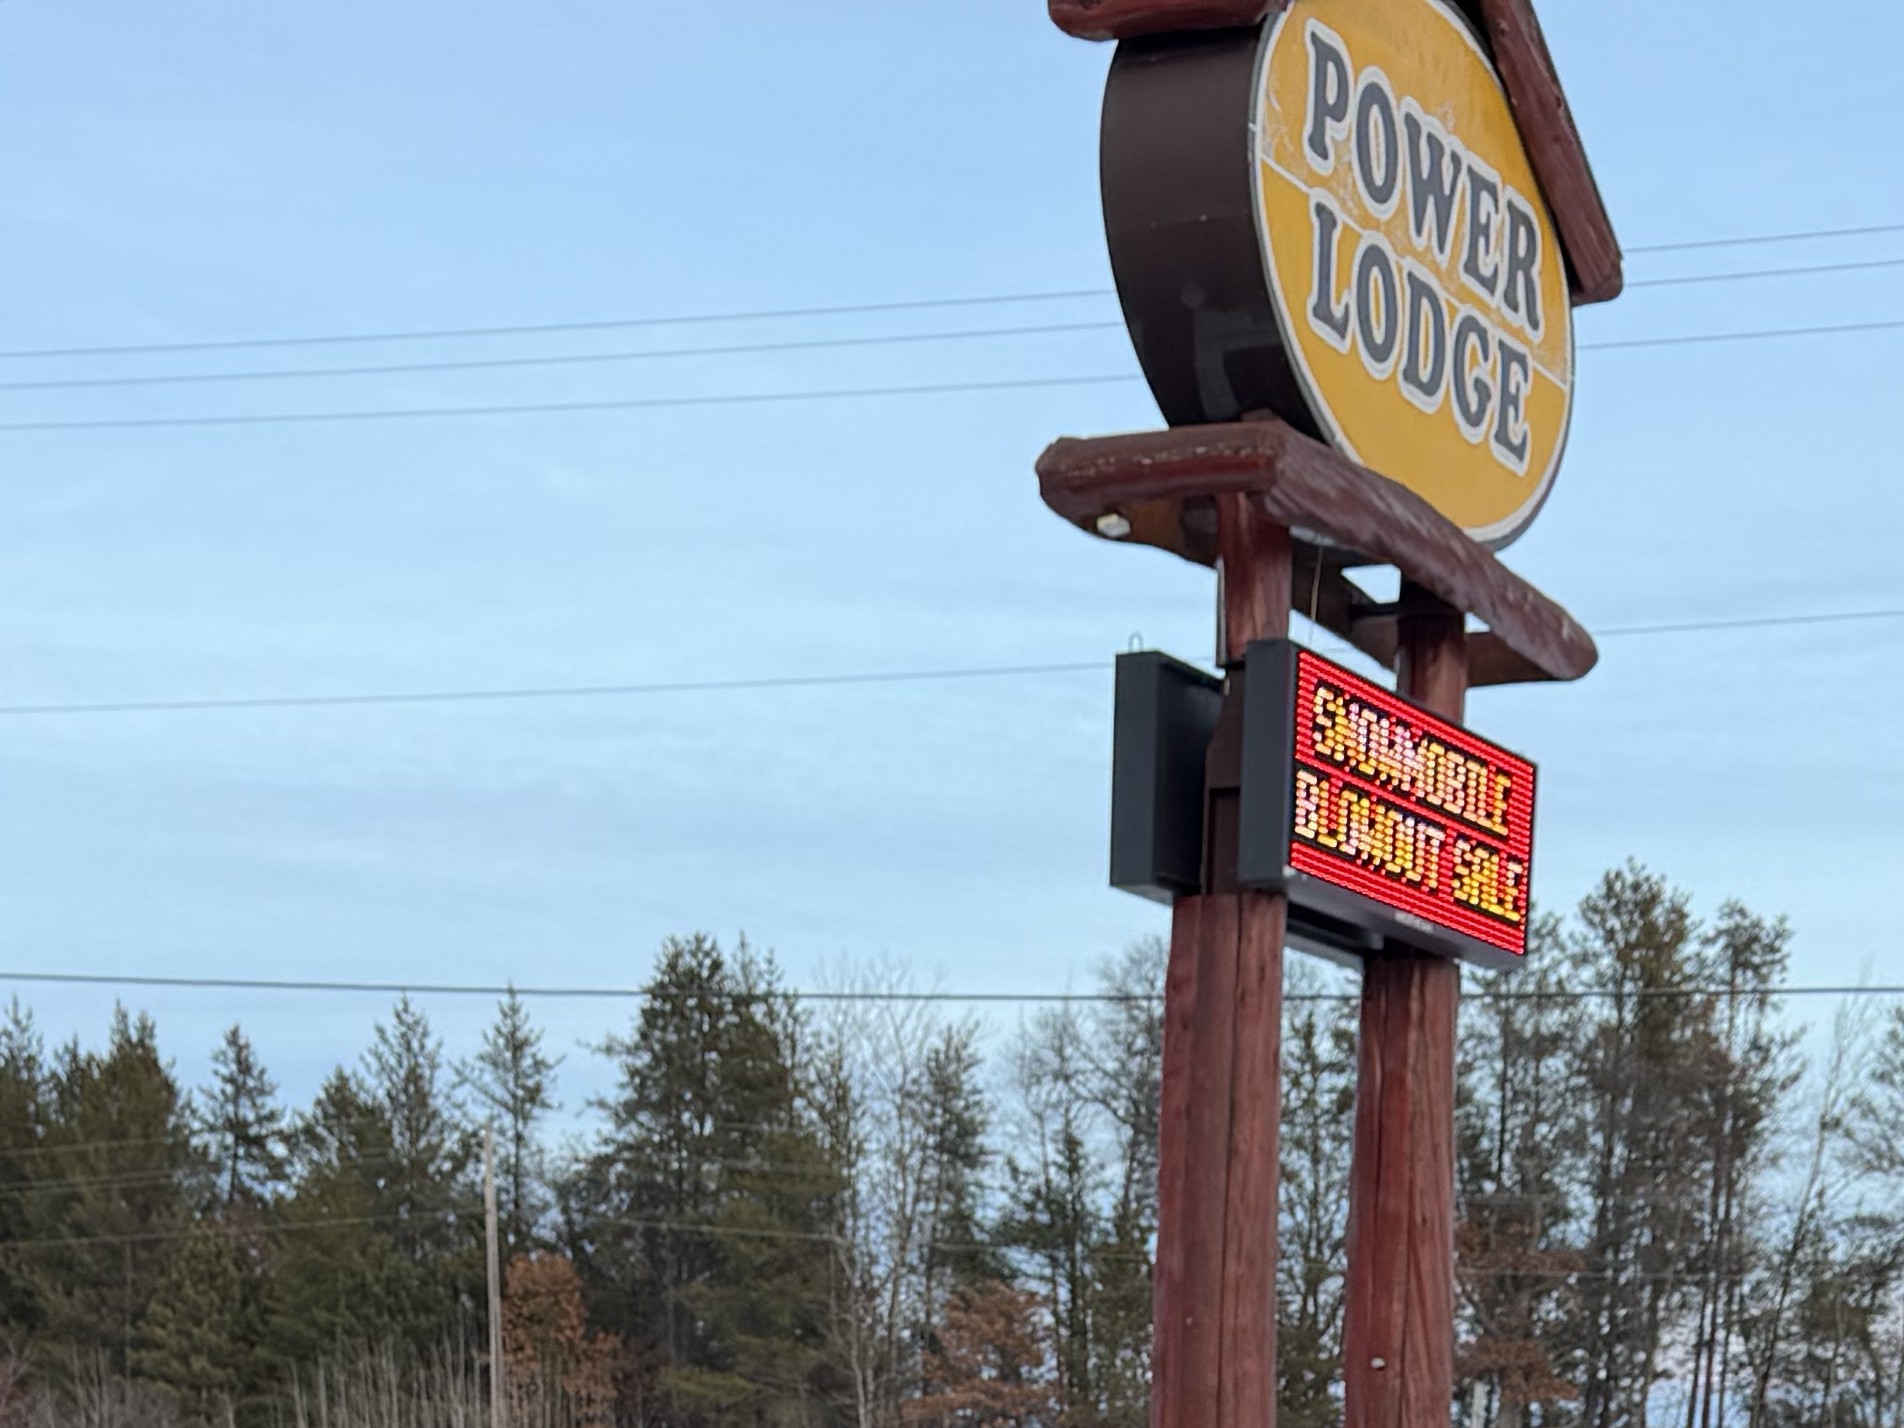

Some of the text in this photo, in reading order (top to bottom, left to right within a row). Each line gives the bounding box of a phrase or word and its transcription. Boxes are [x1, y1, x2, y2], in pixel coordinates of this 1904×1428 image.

[1306, 24, 1542, 338] POWER
[1309, 196, 1530, 470] LODGE
[1294, 767, 1523, 922] BLOWOUT SALE
[1312, 685, 1511, 837] SNOWMOBILE
